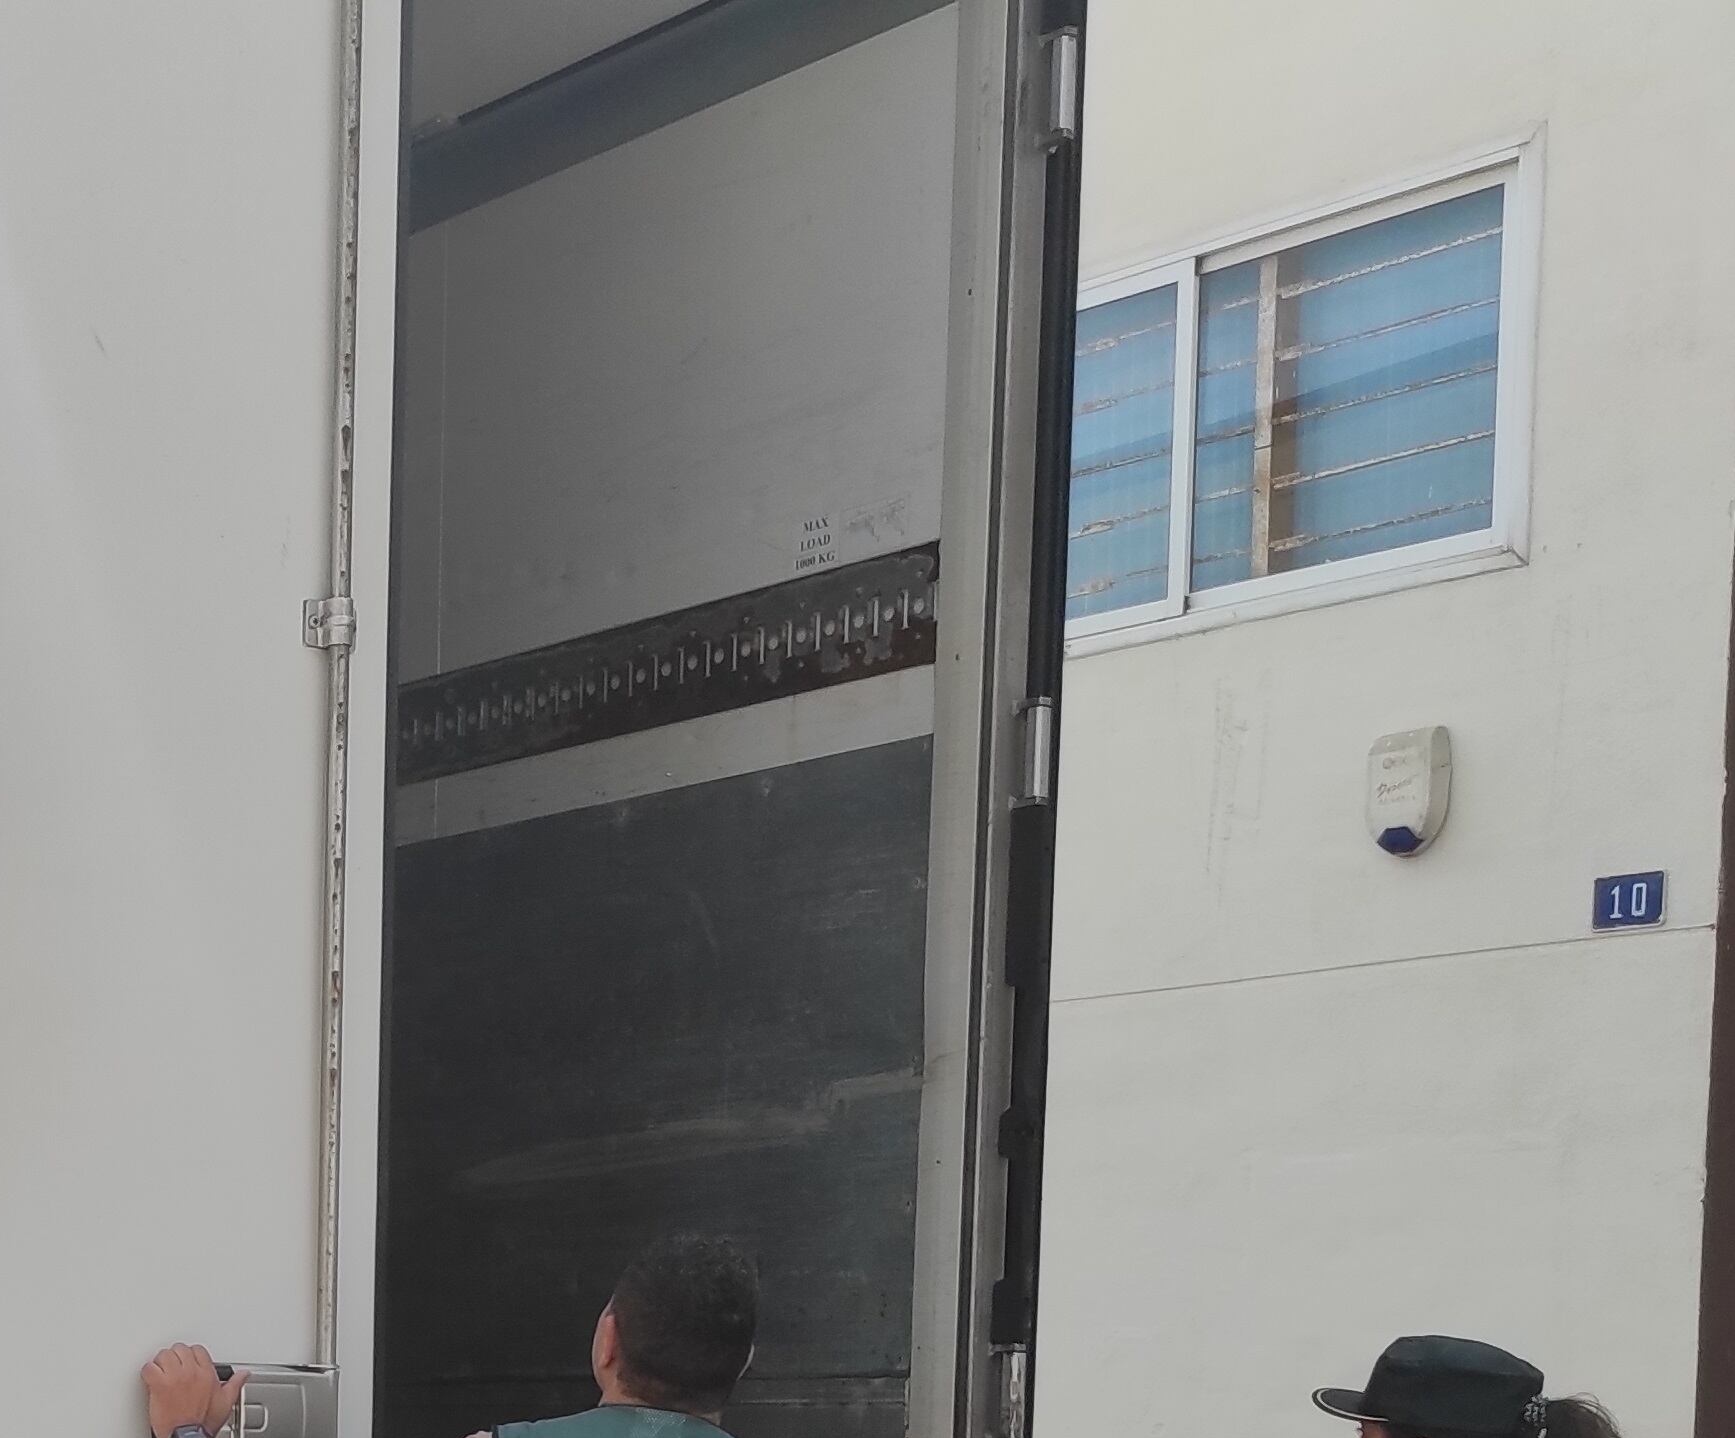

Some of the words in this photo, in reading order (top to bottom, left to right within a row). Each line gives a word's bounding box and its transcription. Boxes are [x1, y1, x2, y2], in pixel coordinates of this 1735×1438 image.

[804, 517, 829, 532] MAX
[800, 534, 830, 552] LOAD
[818, 550, 835, 564] KG
[1609, 882, 1647, 919] 10
